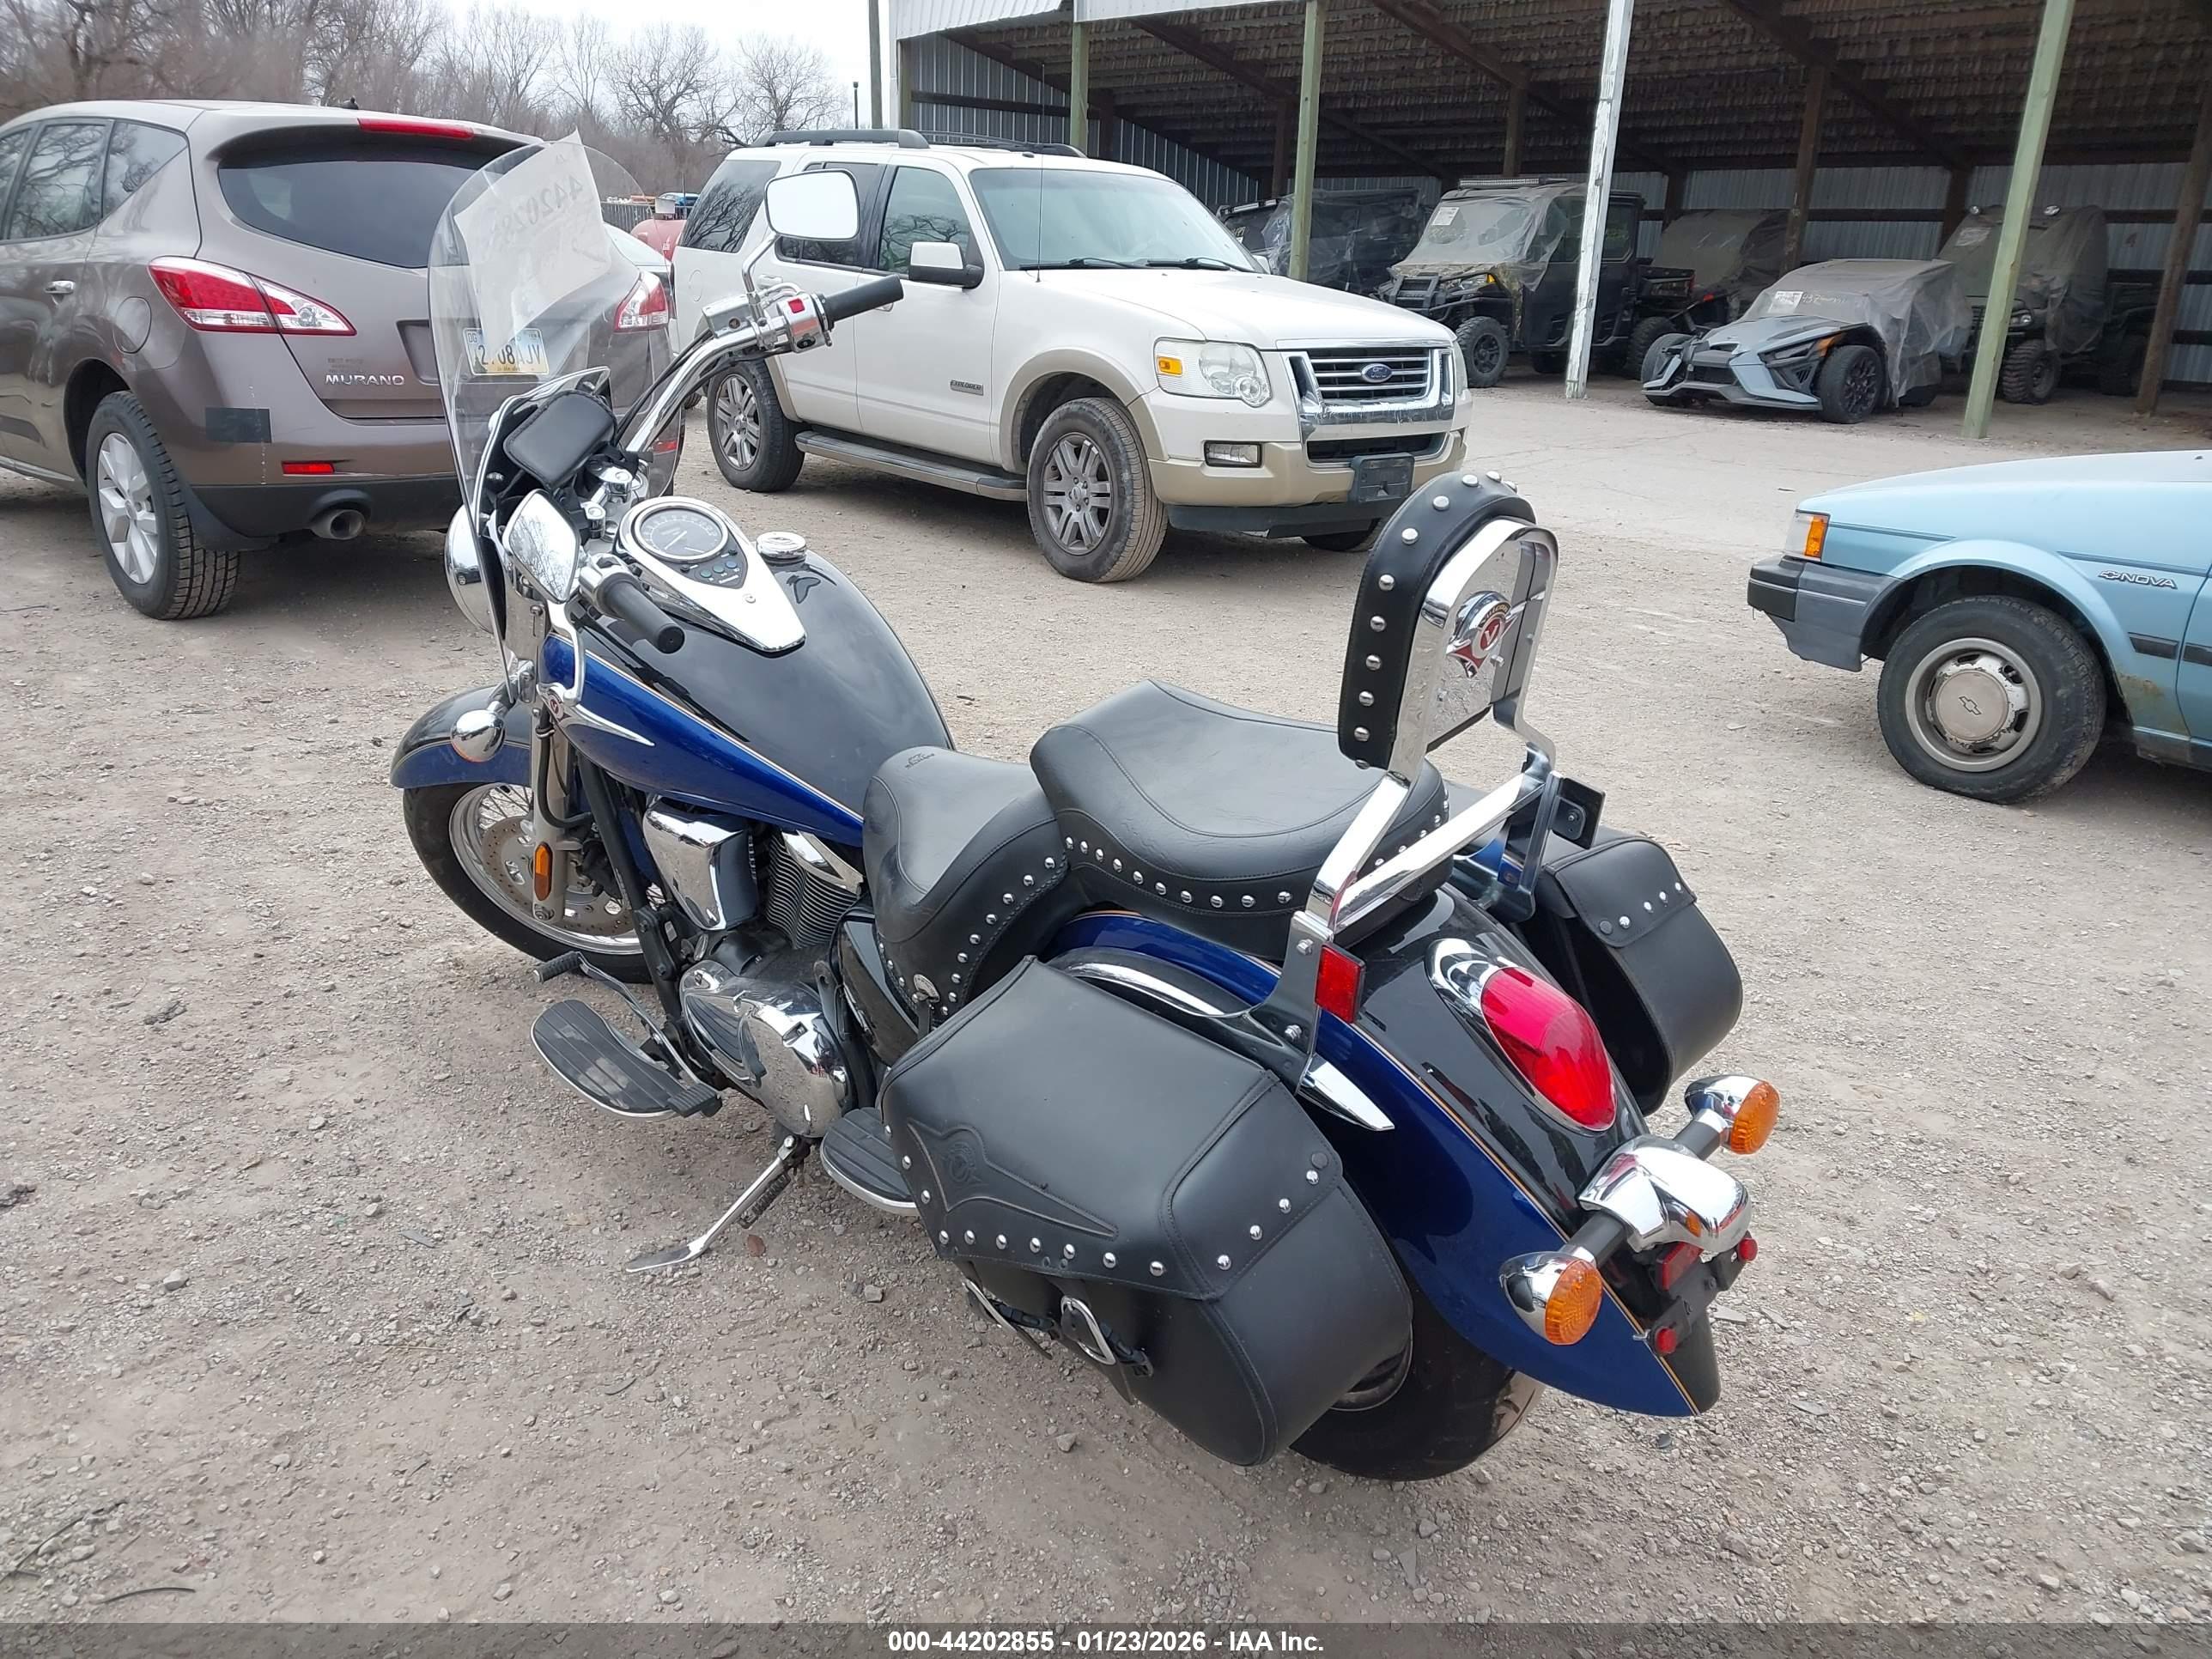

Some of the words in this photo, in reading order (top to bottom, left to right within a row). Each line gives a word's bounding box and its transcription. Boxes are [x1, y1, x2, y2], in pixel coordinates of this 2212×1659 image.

[477, 343, 541, 365] 208AJV
[325, 374, 405, 386] MURANO
[2120, 572, 2178, 589] NOVA
